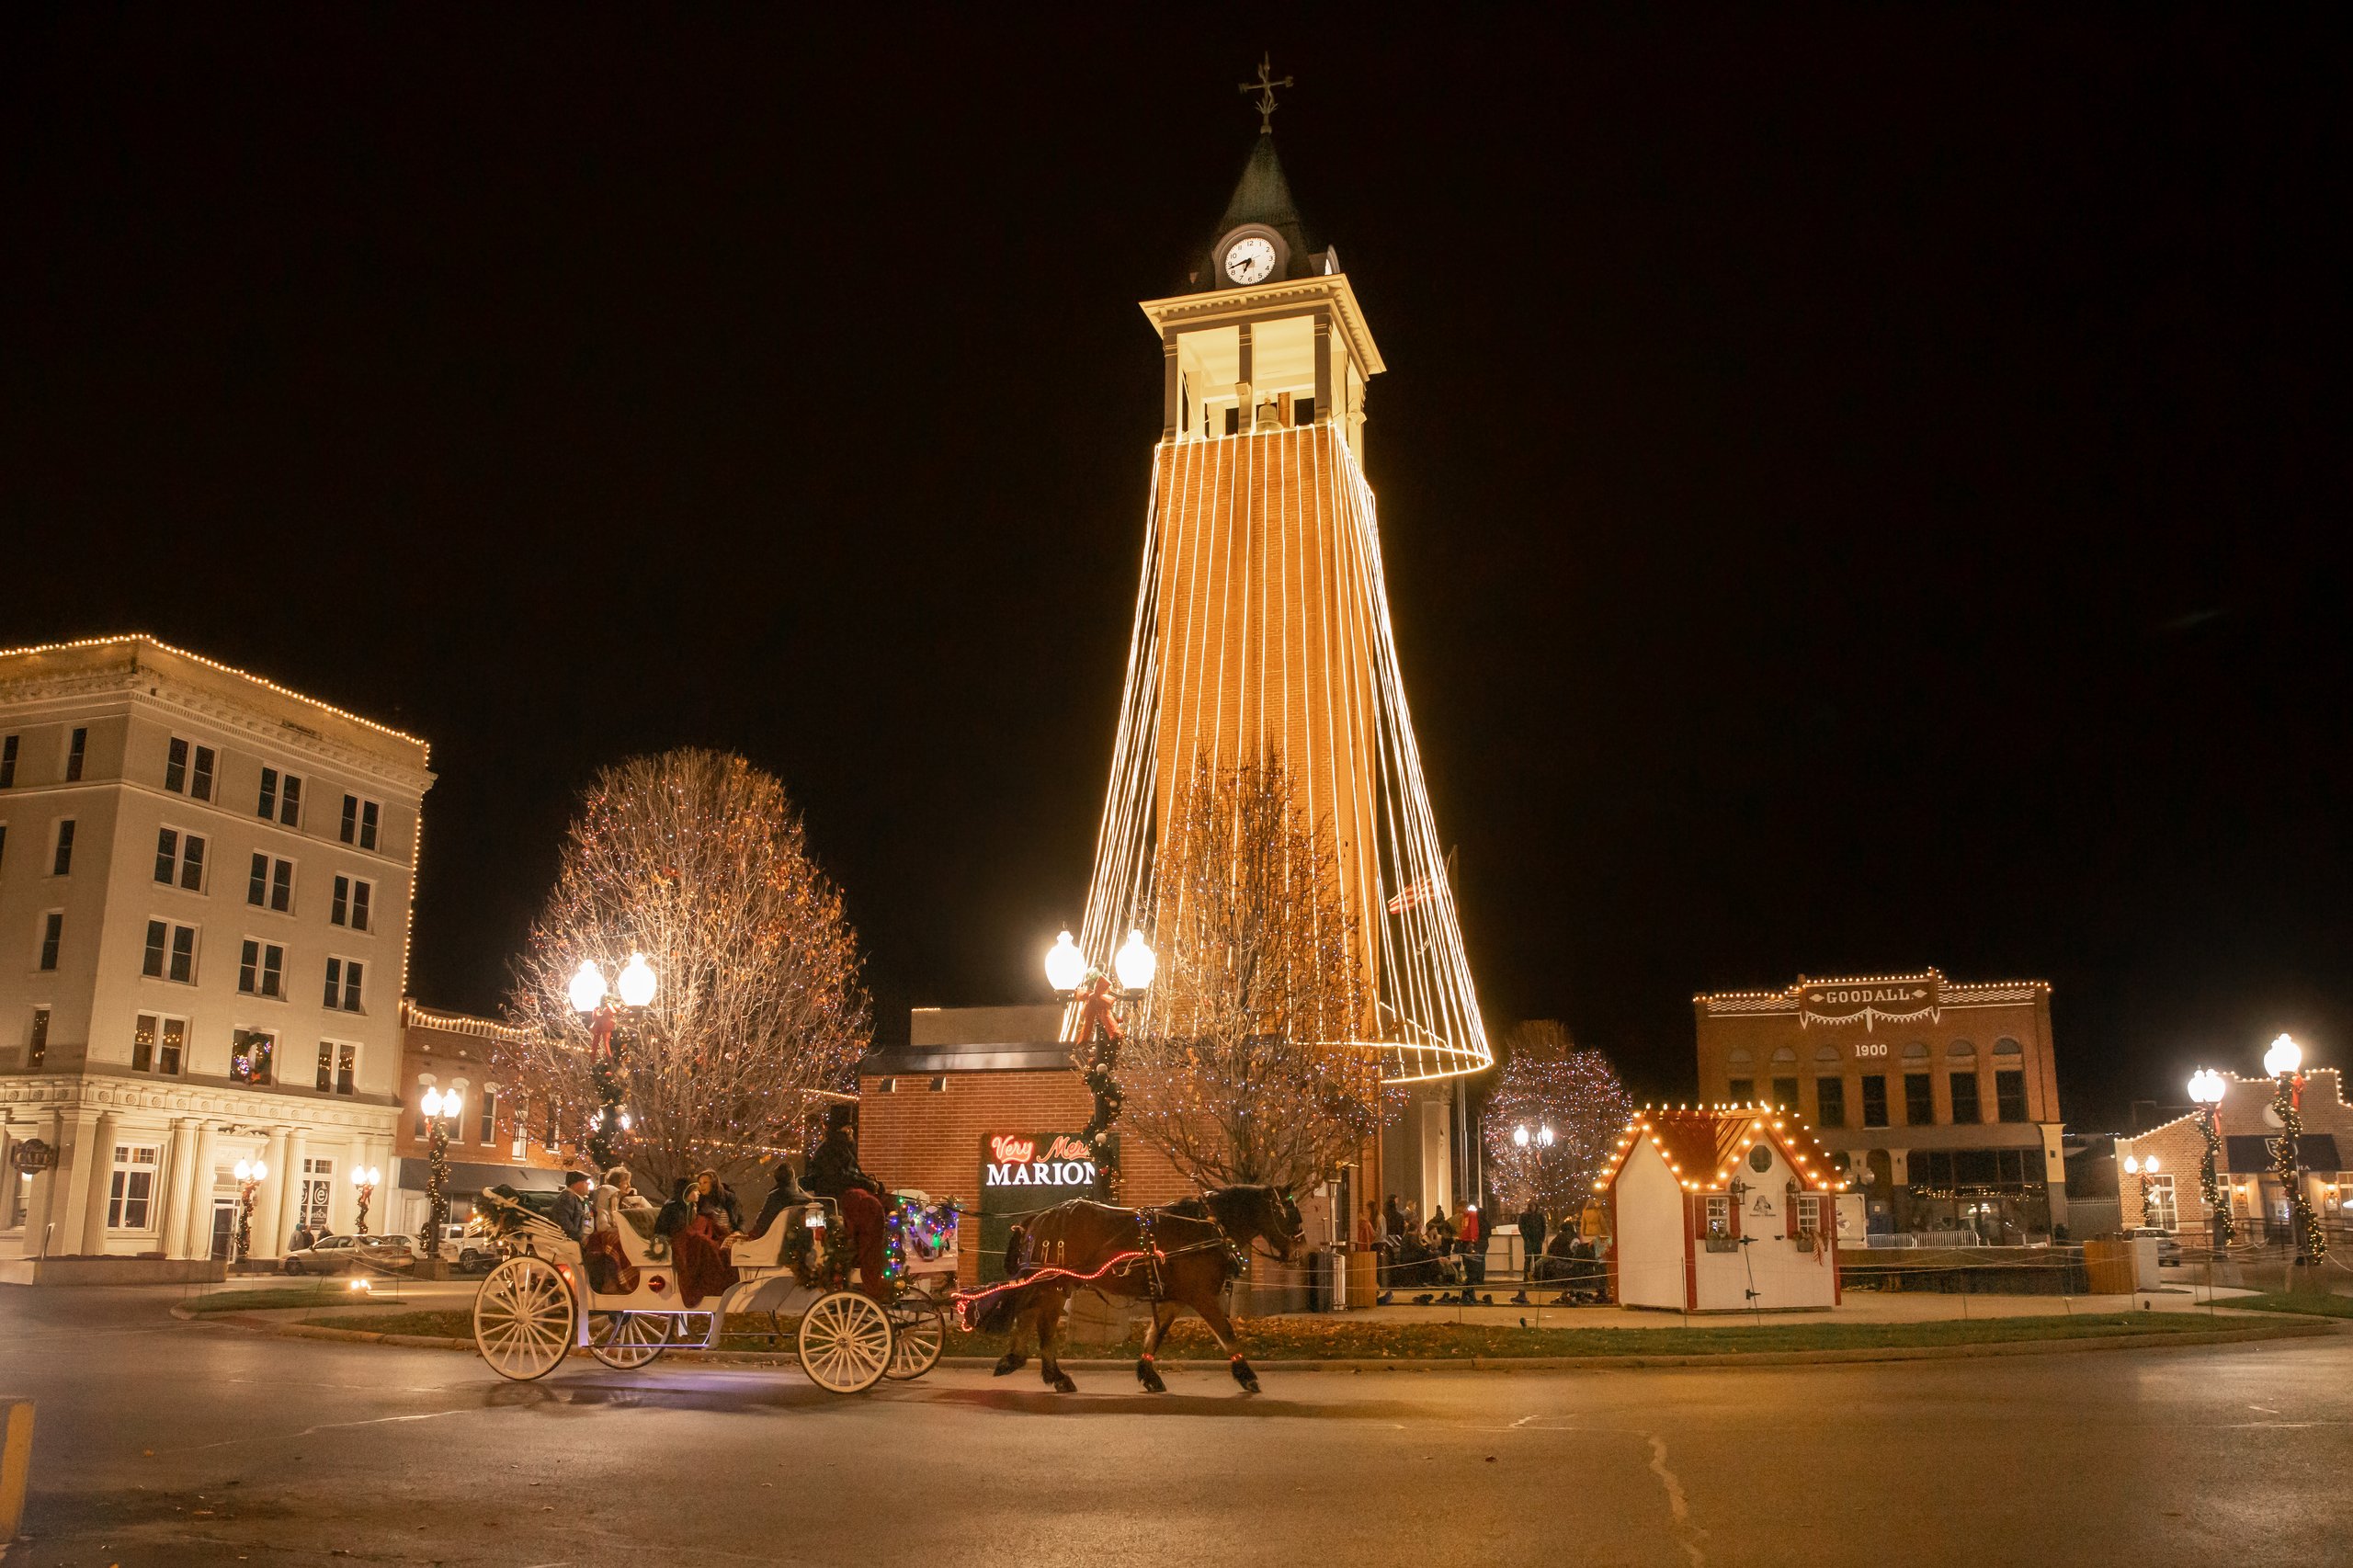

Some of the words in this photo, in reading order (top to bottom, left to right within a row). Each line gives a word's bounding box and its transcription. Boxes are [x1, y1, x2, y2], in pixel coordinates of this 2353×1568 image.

[1855, 1044, 1888, 1057] 1900
[991, 1134, 1034, 1164] Very
[1036, 1135, 1091, 1164] Mer
